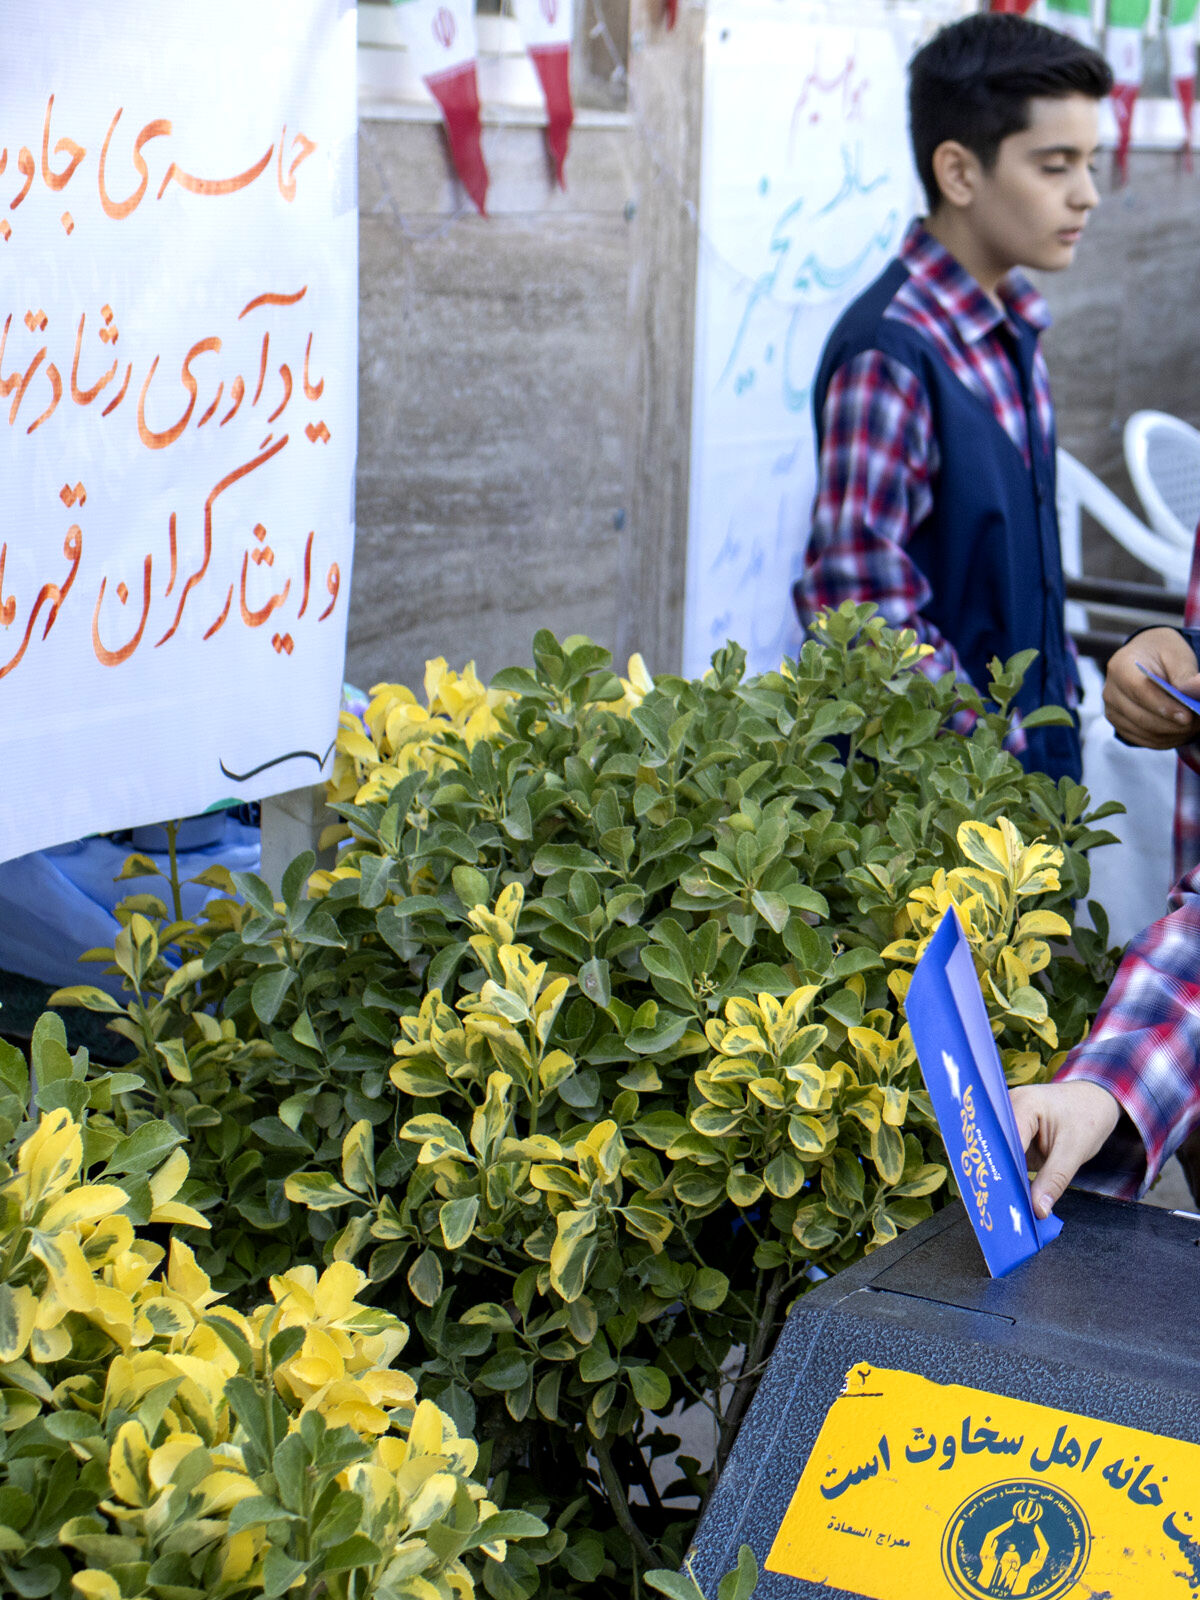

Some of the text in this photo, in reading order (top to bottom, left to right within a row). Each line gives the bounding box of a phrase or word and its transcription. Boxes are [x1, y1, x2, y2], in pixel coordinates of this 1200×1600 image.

[137, 285, 331, 449] یادآوری
[92, 433, 314, 667] ایثارگران
[819, 1434, 890, 1500] است
[904, 1416, 1024, 1471] سخاوت
[1029, 1424, 1103, 1473] اهل
[1101, 1455, 1169, 1506] خانه
[875, 1533, 911, 1548] معراج
